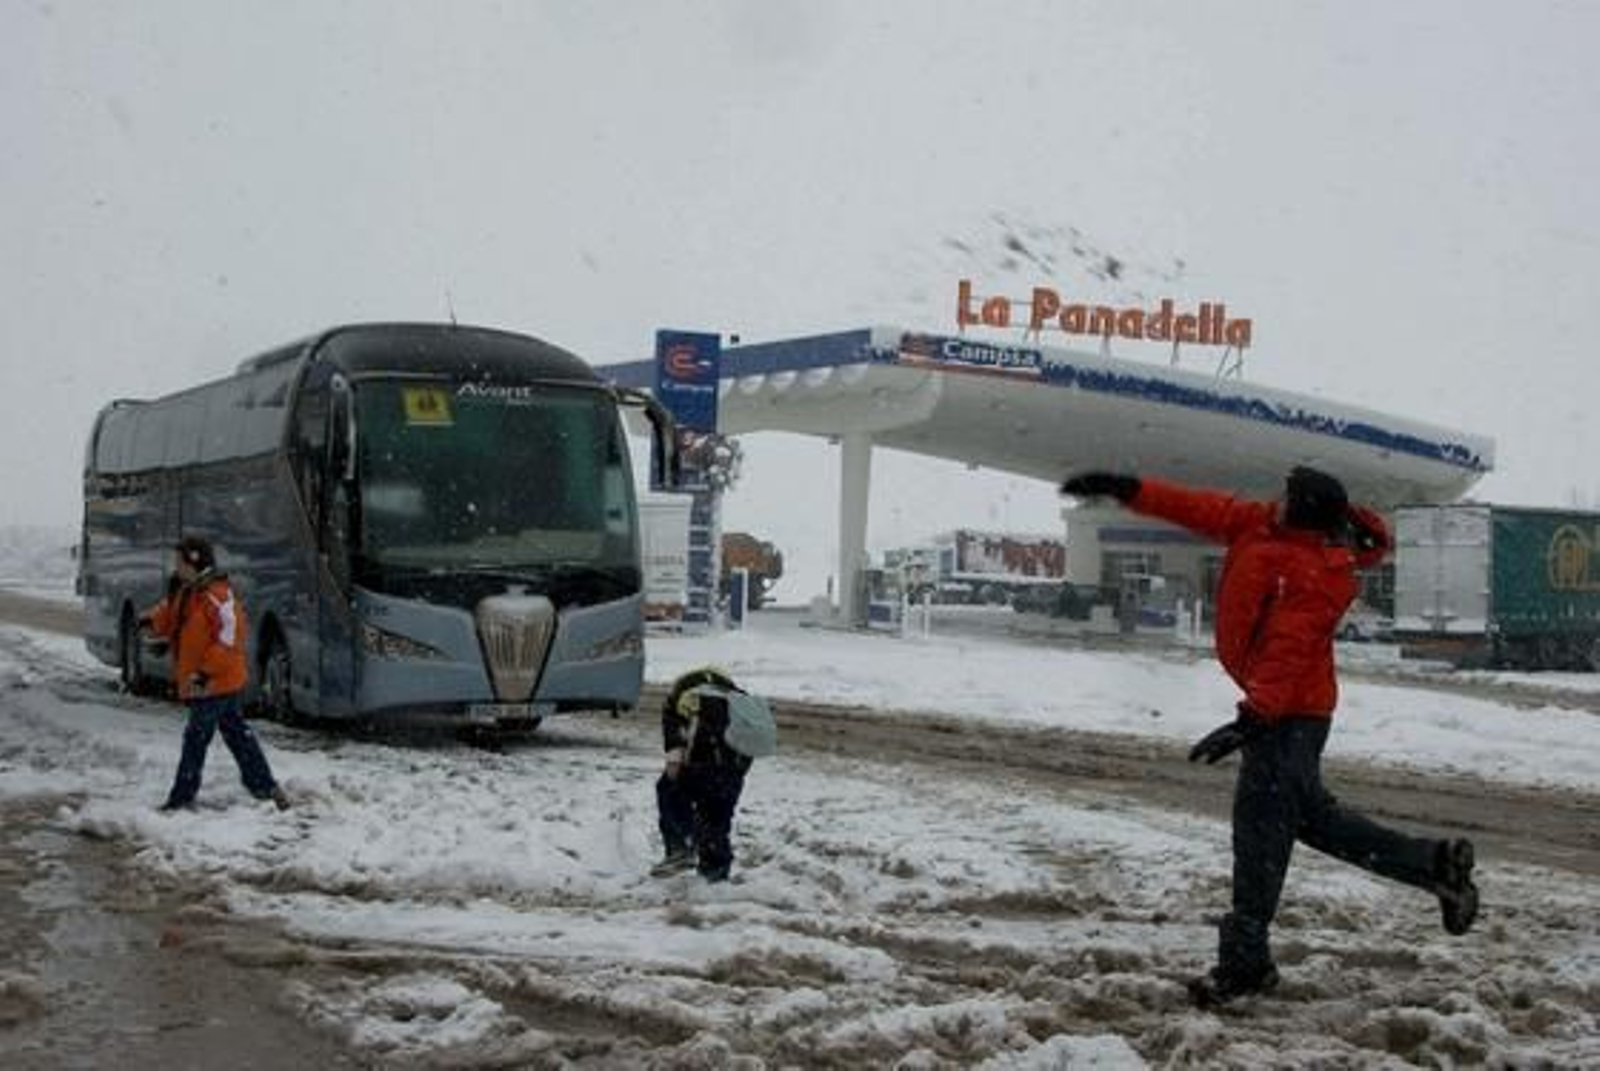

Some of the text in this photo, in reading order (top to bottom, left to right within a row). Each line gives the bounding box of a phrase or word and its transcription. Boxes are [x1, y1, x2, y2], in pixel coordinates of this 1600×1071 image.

[957, 279, 1252, 347] La Panadella
[942, 340, 1037, 367] Campsa
